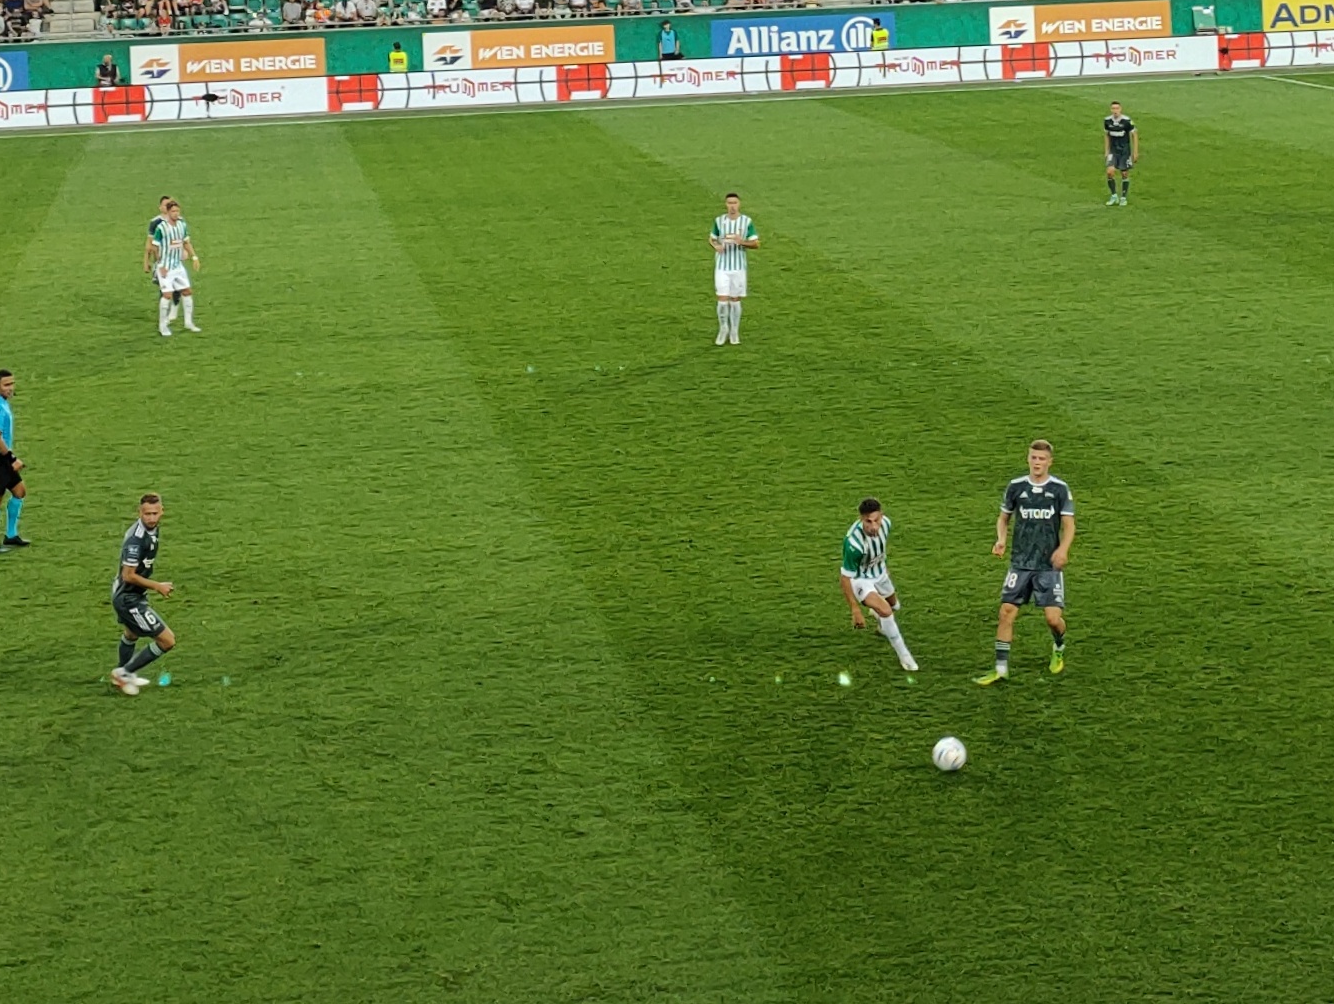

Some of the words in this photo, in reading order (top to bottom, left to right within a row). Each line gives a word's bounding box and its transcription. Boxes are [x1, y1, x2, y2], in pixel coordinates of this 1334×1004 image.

[1041, 20, 1086, 34] WIEN
[1091, 16, 1163, 32] ENERGIE
[727, 25, 835, 55] Allianz
[478, 45, 525, 61] WIEN
[530, 42, 605, 58] ENERGIE
[186, 57, 234, 74] WIEN
[240, 55, 317, 72] ENERGIE
[144, 610, 157, 626] 6
